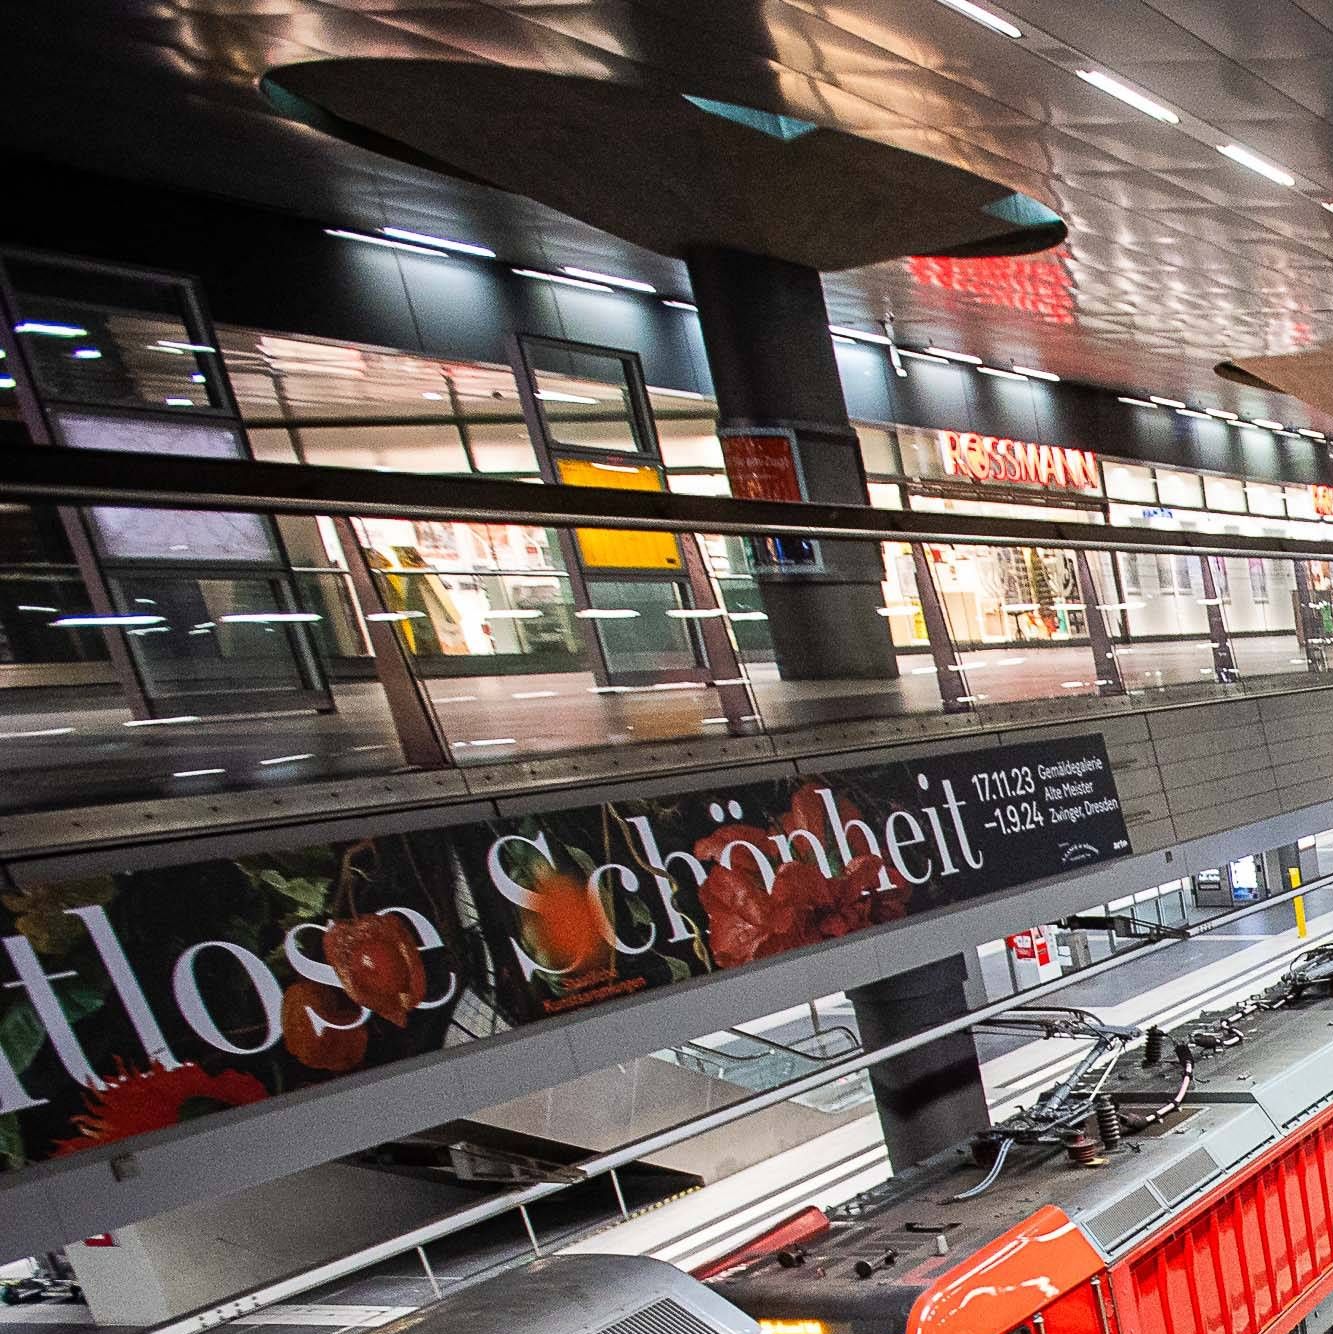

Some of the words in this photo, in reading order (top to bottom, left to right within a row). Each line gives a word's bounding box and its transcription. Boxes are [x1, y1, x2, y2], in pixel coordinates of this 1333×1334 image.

[939, 429, 1098, 488] ROSSMANN
[971, 766, 1035, 802] 17.11.23
[1037, 756, 1103, 780] Gemäldegalerie
[1044, 786, 1063, 801] Alte
[1062, 781, 1094, 799] Meister
[1049, 805, 1086, 824] Zwinger,
[1084, 796, 1119, 816] Dresden
[0, 904, 457, 1114] tlose
[486, 773, 984, 983] Schönheit
